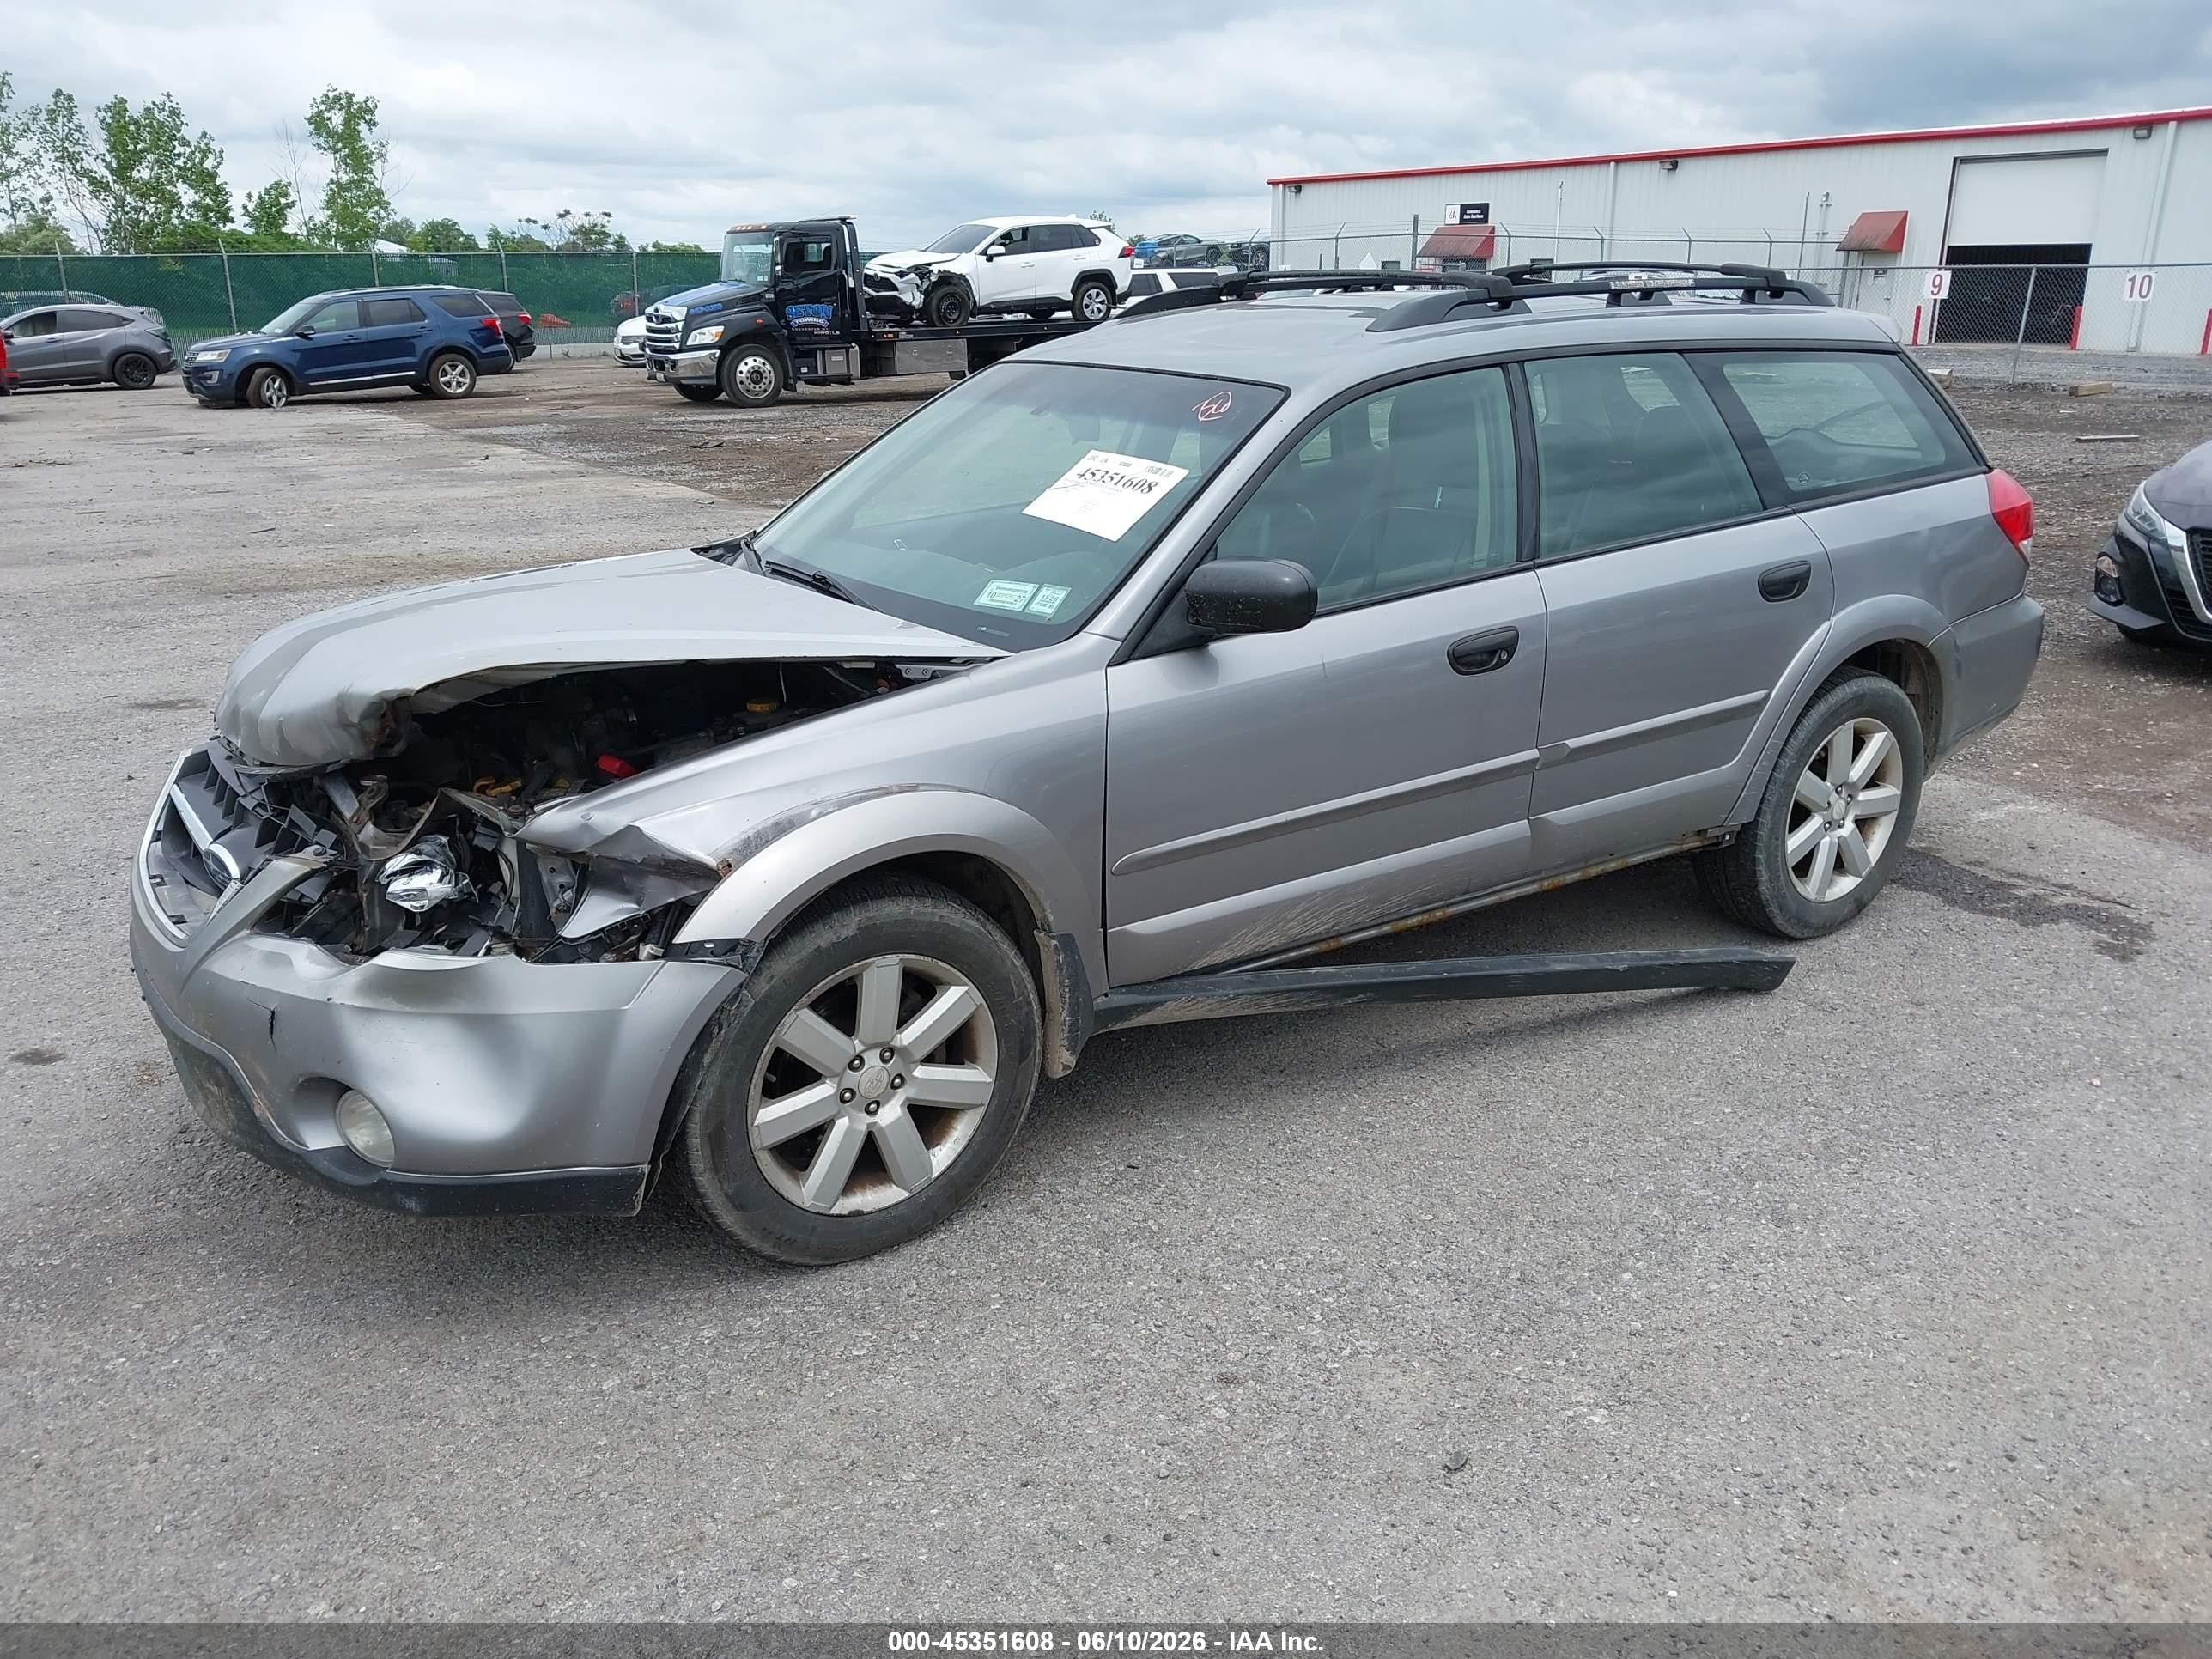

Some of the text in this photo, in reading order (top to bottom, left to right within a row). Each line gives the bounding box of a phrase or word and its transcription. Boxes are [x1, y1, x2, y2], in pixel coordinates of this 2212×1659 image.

[1931, 274, 1943, 296] 9
[2127, 274, 2153, 299] 10
[793, 317, 826, 327] TOWING
[1076, 467, 1158, 495] 45351608
[987, 590, 997, 599] 10
